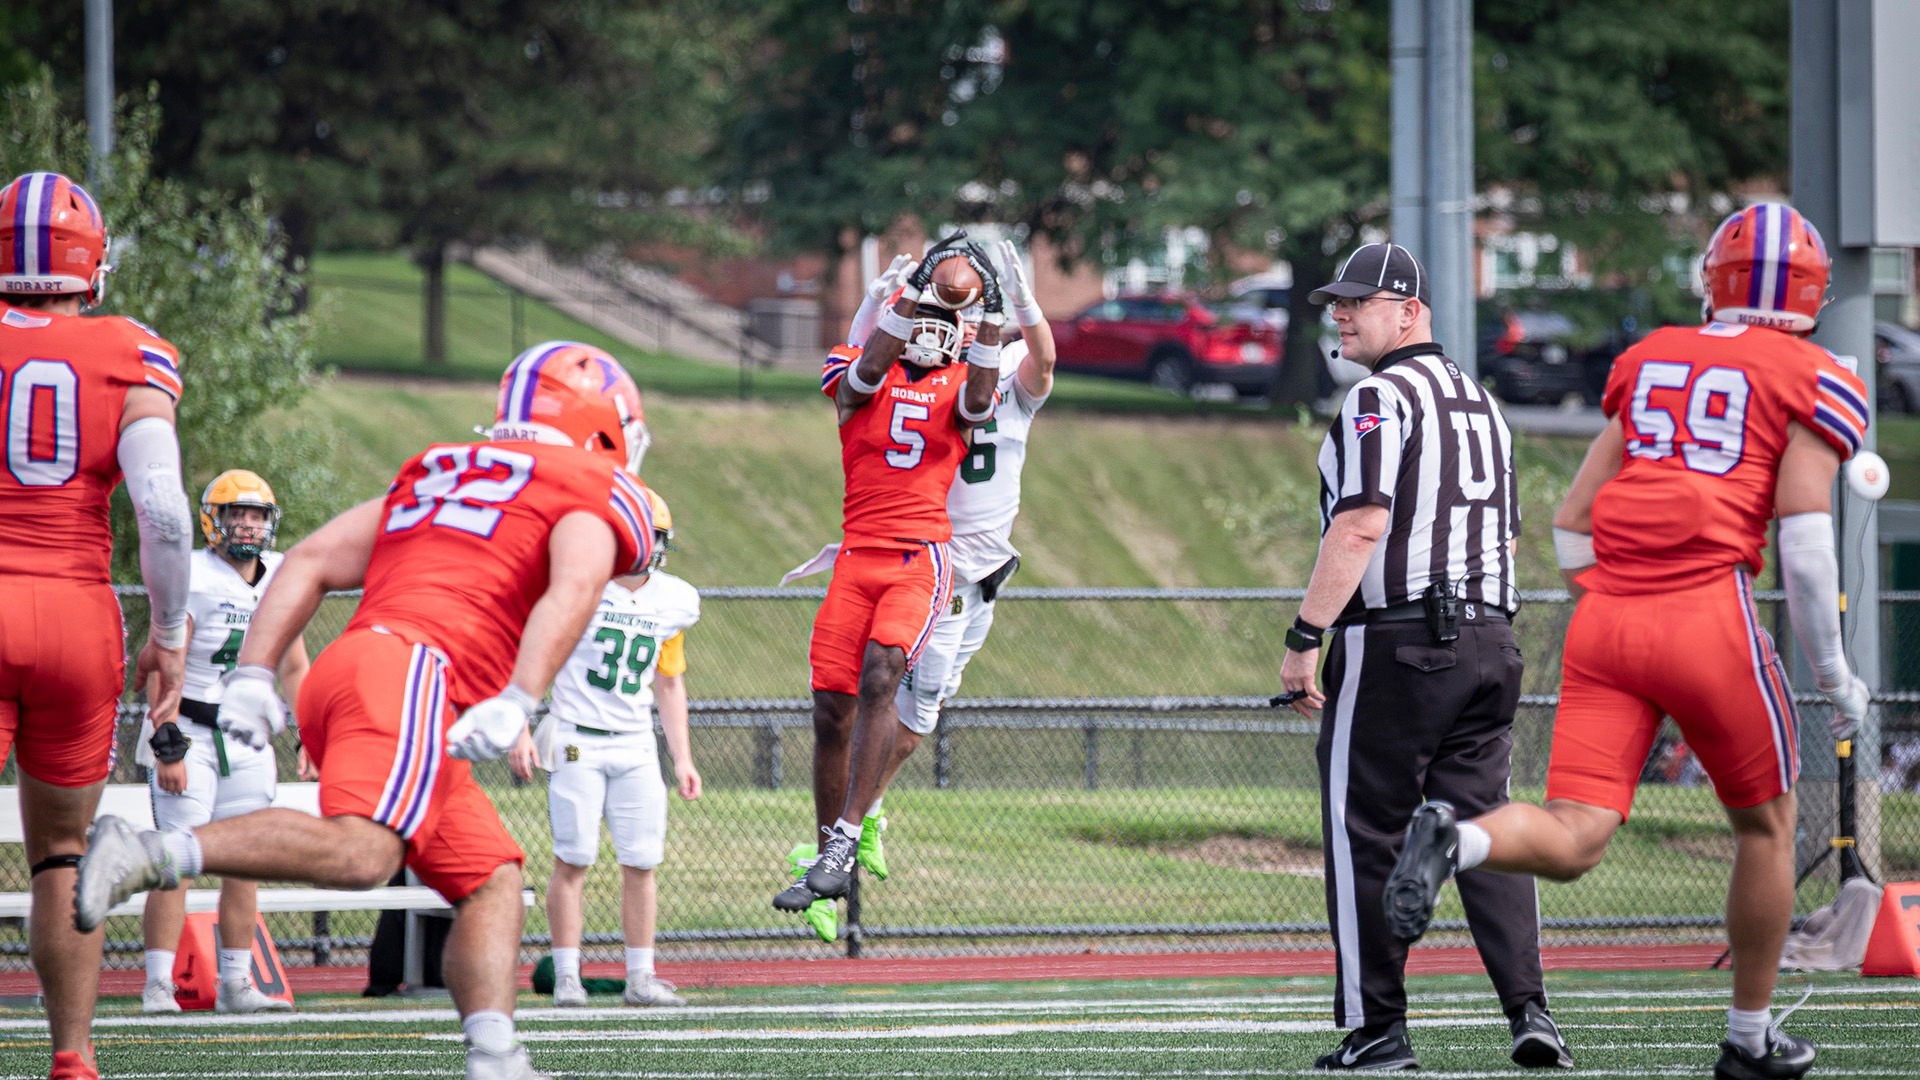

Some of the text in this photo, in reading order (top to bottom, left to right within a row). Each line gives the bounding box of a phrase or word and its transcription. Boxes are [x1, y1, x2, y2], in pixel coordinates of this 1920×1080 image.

[6, 281, 63, 292] HOBART
[1738, 314, 1795, 329] HOBART
[890, 387, 937, 403] HOBART
[1626, 359, 1752, 476] 59
[884, 401, 930, 470] 5
[960, 416, 998, 485] 6
[1449, 411, 1496, 500] U
[385, 445, 535, 540] 92
[586, 626, 657, 694] 39
